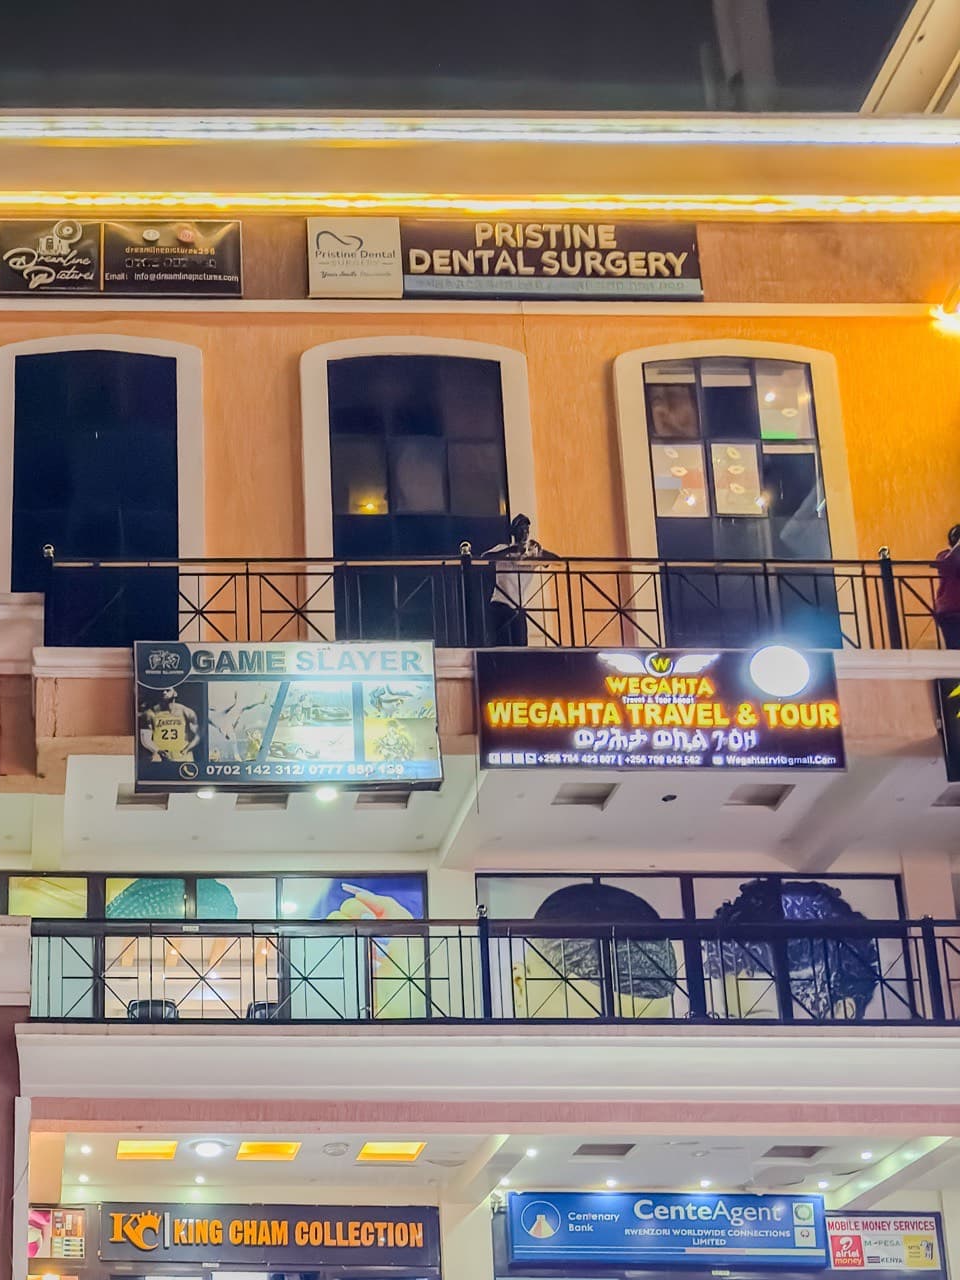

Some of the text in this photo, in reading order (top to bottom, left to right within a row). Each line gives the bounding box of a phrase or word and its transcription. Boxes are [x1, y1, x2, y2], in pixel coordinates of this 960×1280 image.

[475, 223, 617, 249] PRISTINE
[3, 247, 91, 271] Dreamline
[316, 249, 396, 259] Pristine Dental
[409, 248, 689, 277] DENTAL SURGERY
[23, 265, 94, 289] Pictures
[191, 649, 425, 674] GAME SLAYER
[651, 657, 671, 672] W
[605, 676, 715, 696] WEGAHTA
[487, 701, 841, 728] WEGAHTA TRAVEL & TOUR
[161, 728, 178, 741] 23
[206, 764, 241, 776] 0702
[245, 764, 271, 776] 142
[309, 764, 343, 776] 0777
[568, 1211, 620, 1223] Centenary
[633, 1198, 783, 1226] CenteAgent
[174, 1217, 424, 1249] KING CHAM COLLECTION
[568, 1223, 594, 1233] Bank
[625, 1228, 791, 1238] RWENZORI WORLDWIDE CONNECTIONS
[828, 1220, 935, 1231] MOBILE MONEY SERVICES
[692, 1238, 726, 1246] LIMITED
[835, 1258, 862, 1266] money
